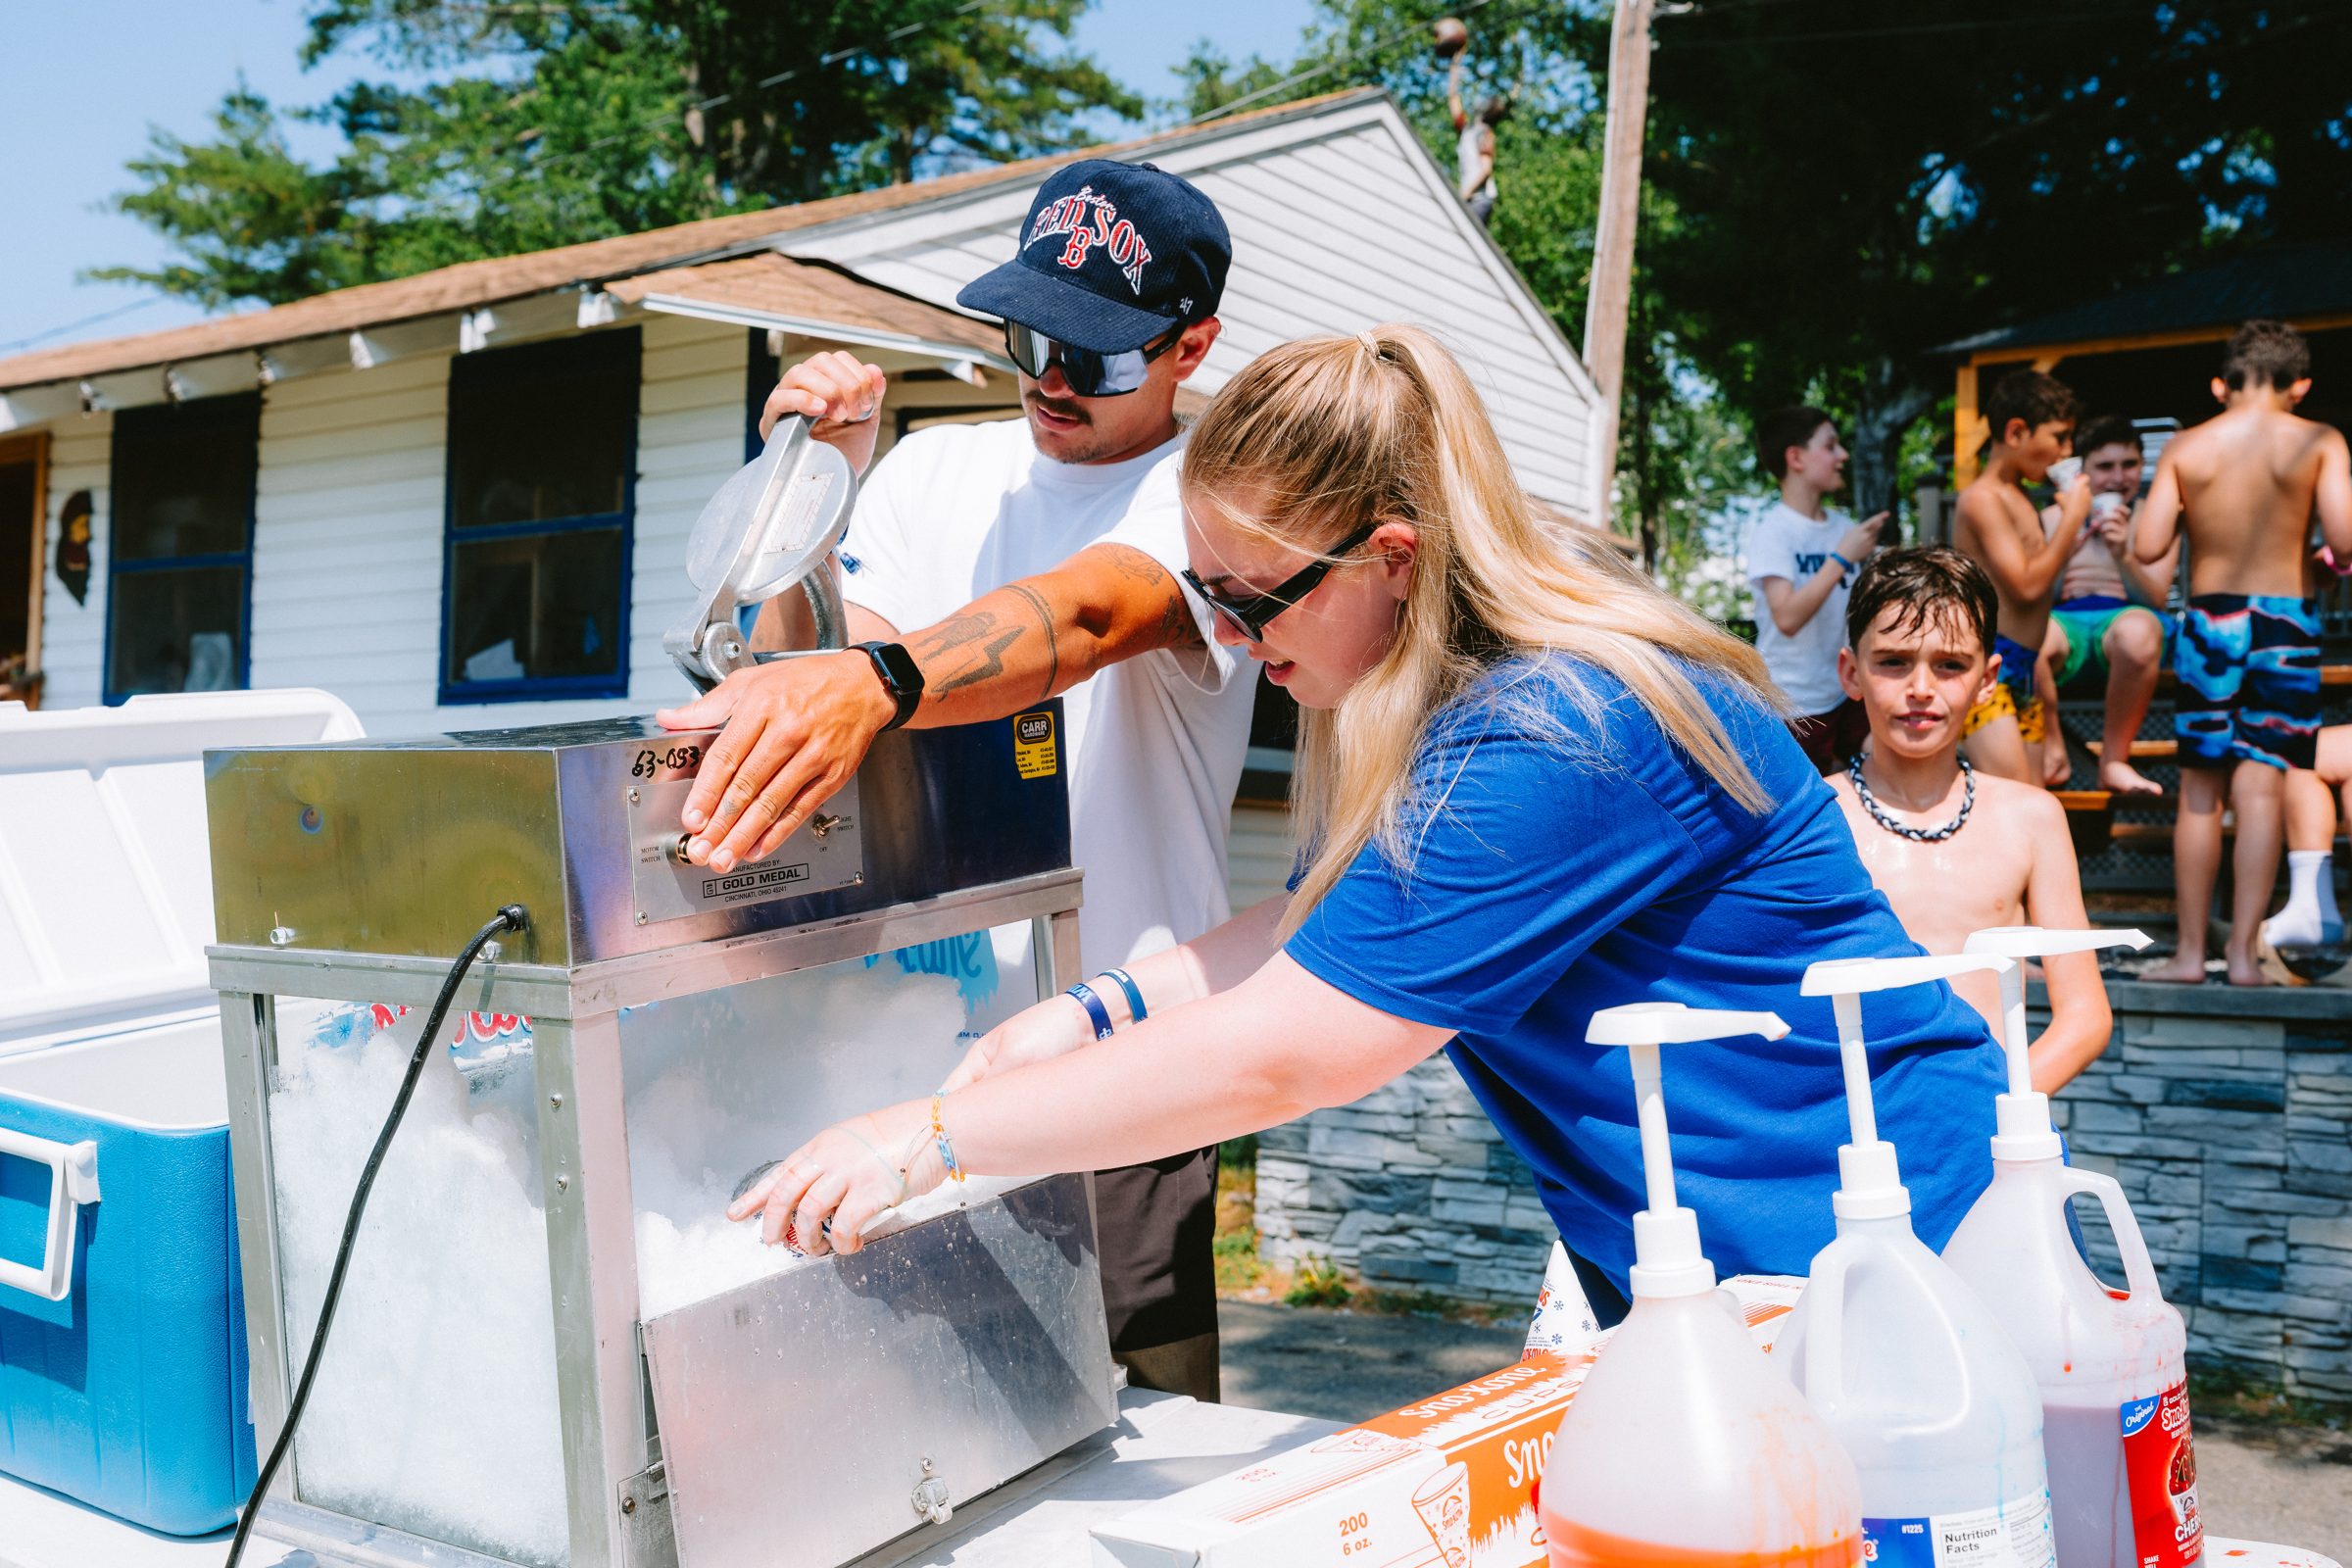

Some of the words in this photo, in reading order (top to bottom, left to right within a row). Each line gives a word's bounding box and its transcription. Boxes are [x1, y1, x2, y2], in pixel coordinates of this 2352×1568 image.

[1075, 185, 1116, 212] Boston
[1024, 195, 1086, 251] RED
[1092, 206, 1152, 295] SOX
[1057, 224, 1092, 270] B
[1022, 720, 1047, 734] CARR
[730, 860, 771, 873] ANUFACTURED
[722, 875, 755, 890] GOLD
[760, 867, 801, 884] MEDAL
[725, 891, 757, 903] CINCINNATI,
[1398, 1366, 1546, 1419] Sno-Kone
[2126, 1400, 2154, 1428] Original
[1340, 1512, 1368, 1537] 200
[1944, 1528, 1997, 1544] Nutrition
[1343, 1544, 1351, 1556] 6
[1354, 1538, 1372, 1550] oz.
[1946, 1543, 1980, 1554] Facts
[2143, 1555, 2160, 1565] SHAKE
